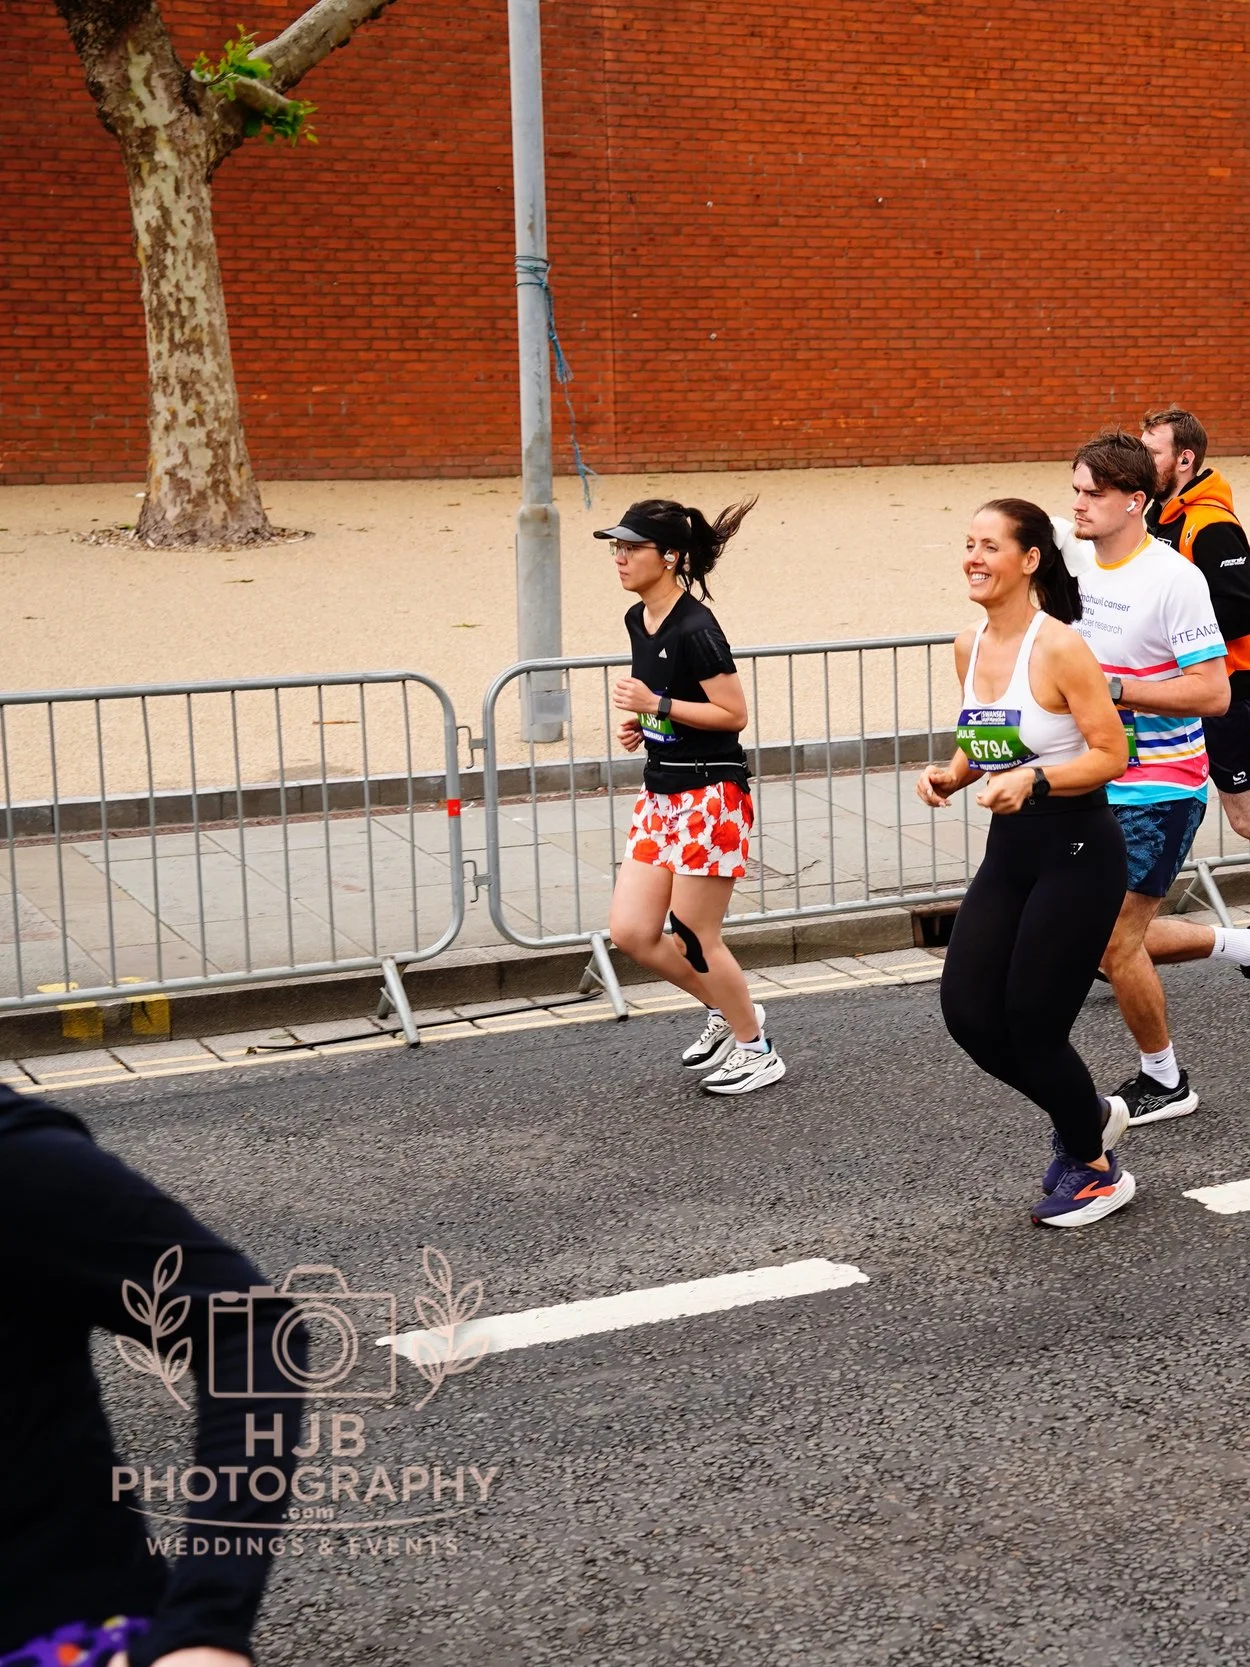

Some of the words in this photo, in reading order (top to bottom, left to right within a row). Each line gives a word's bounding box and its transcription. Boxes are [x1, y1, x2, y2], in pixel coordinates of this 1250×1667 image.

[1080, 593, 1105, 608] mchwil
[1103, 600, 1131, 612] canser
[1094, 620, 1123, 635] research
[957, 729, 977, 739] JULIE
[970, 740, 1013, 759] 6794
